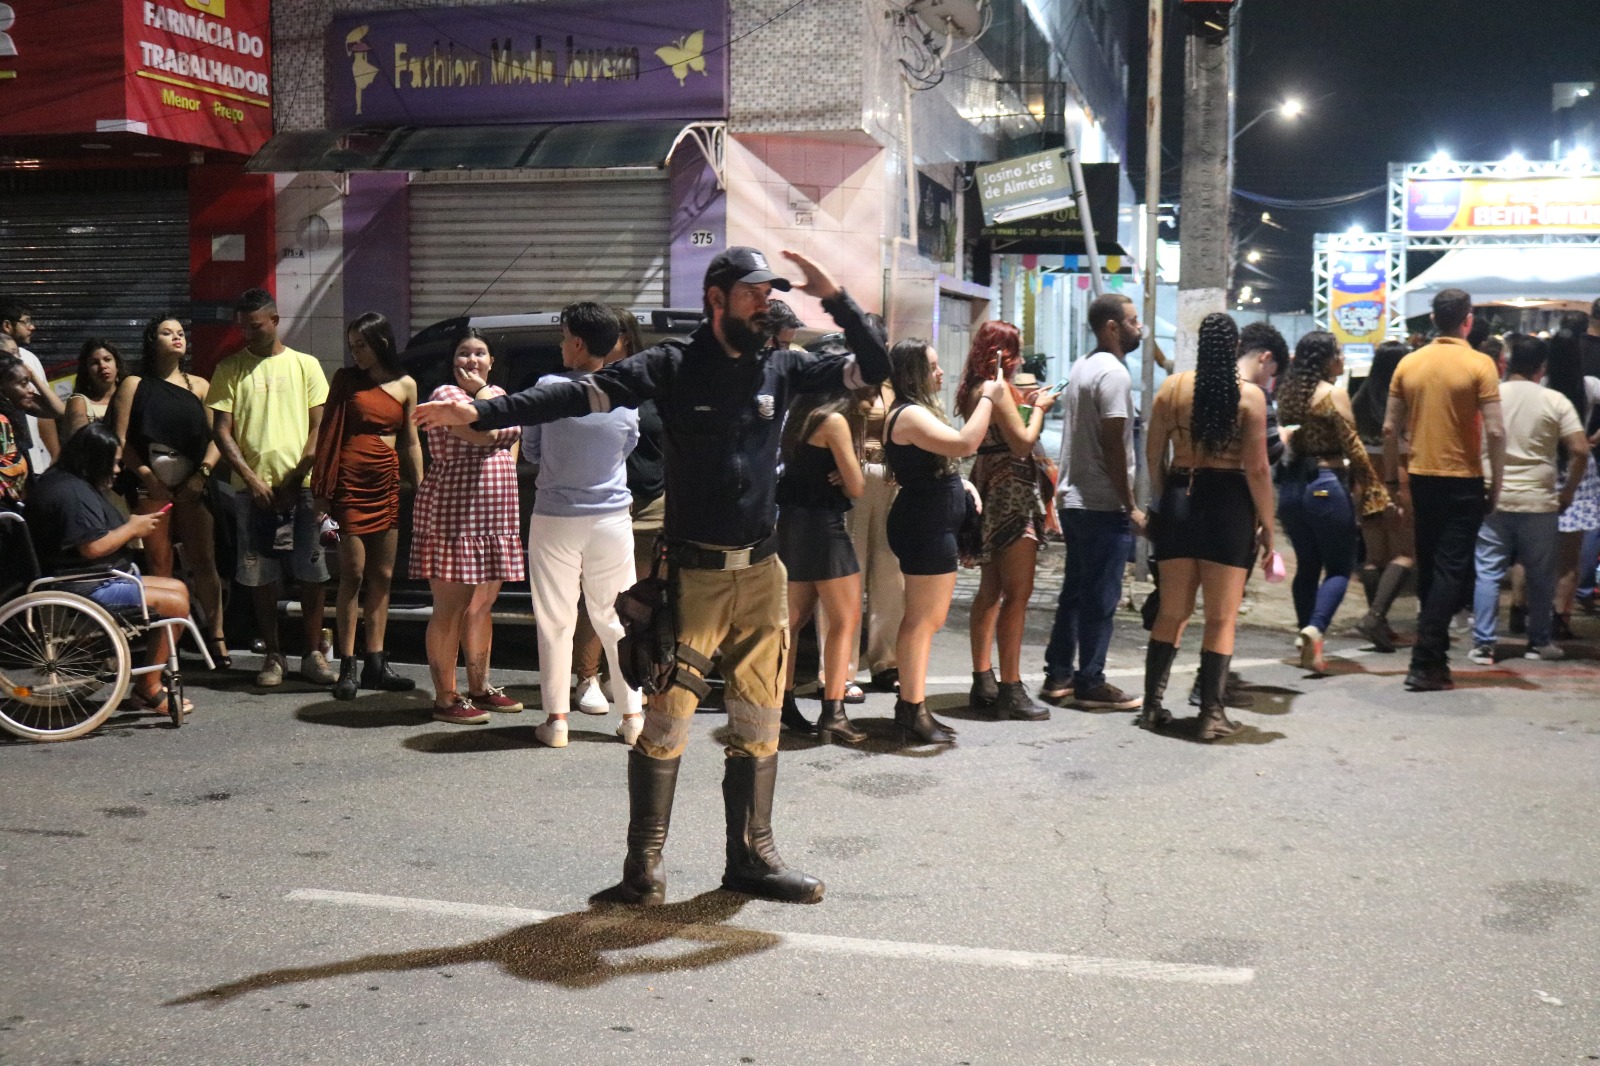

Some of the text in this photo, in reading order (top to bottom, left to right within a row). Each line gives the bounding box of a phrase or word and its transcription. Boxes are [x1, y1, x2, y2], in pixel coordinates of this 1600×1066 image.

[142, 1, 264, 58] FARMÁCIA DO
[139, 41, 269, 96] TRABALHADOR
[394, 41, 481, 89] Fashion
[491, 38, 556, 85] Moda
[162, 88, 245, 124] Menor Preço
[982, 156, 1053, 186] Josino José
[984, 173, 1054, 200] de Almeida
[692, 232, 713, 245] 375
